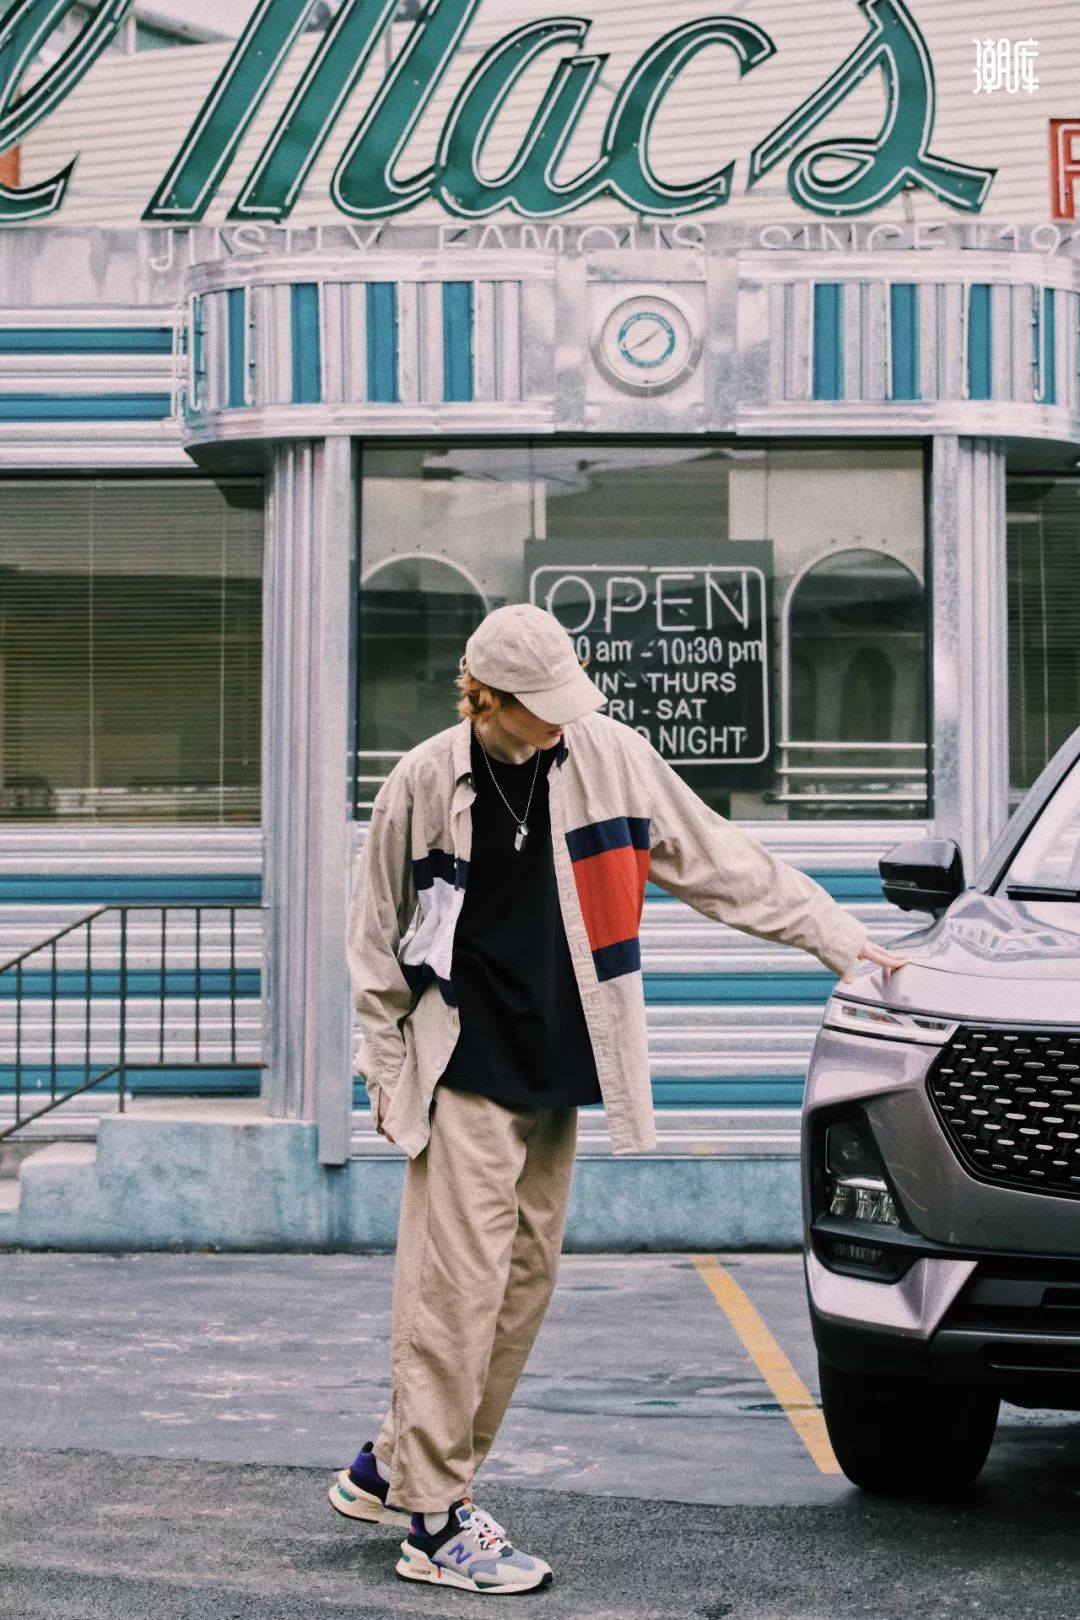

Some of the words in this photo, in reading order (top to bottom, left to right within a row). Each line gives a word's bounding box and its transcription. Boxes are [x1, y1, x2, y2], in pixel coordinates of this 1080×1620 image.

[546, 571, 749, 634] OPEN
[595, 639, 632, 662] am
[728, 640, 763, 669] pm
[646, 671, 737, 693] THURS
[656, 698, 707, 720] SAT
